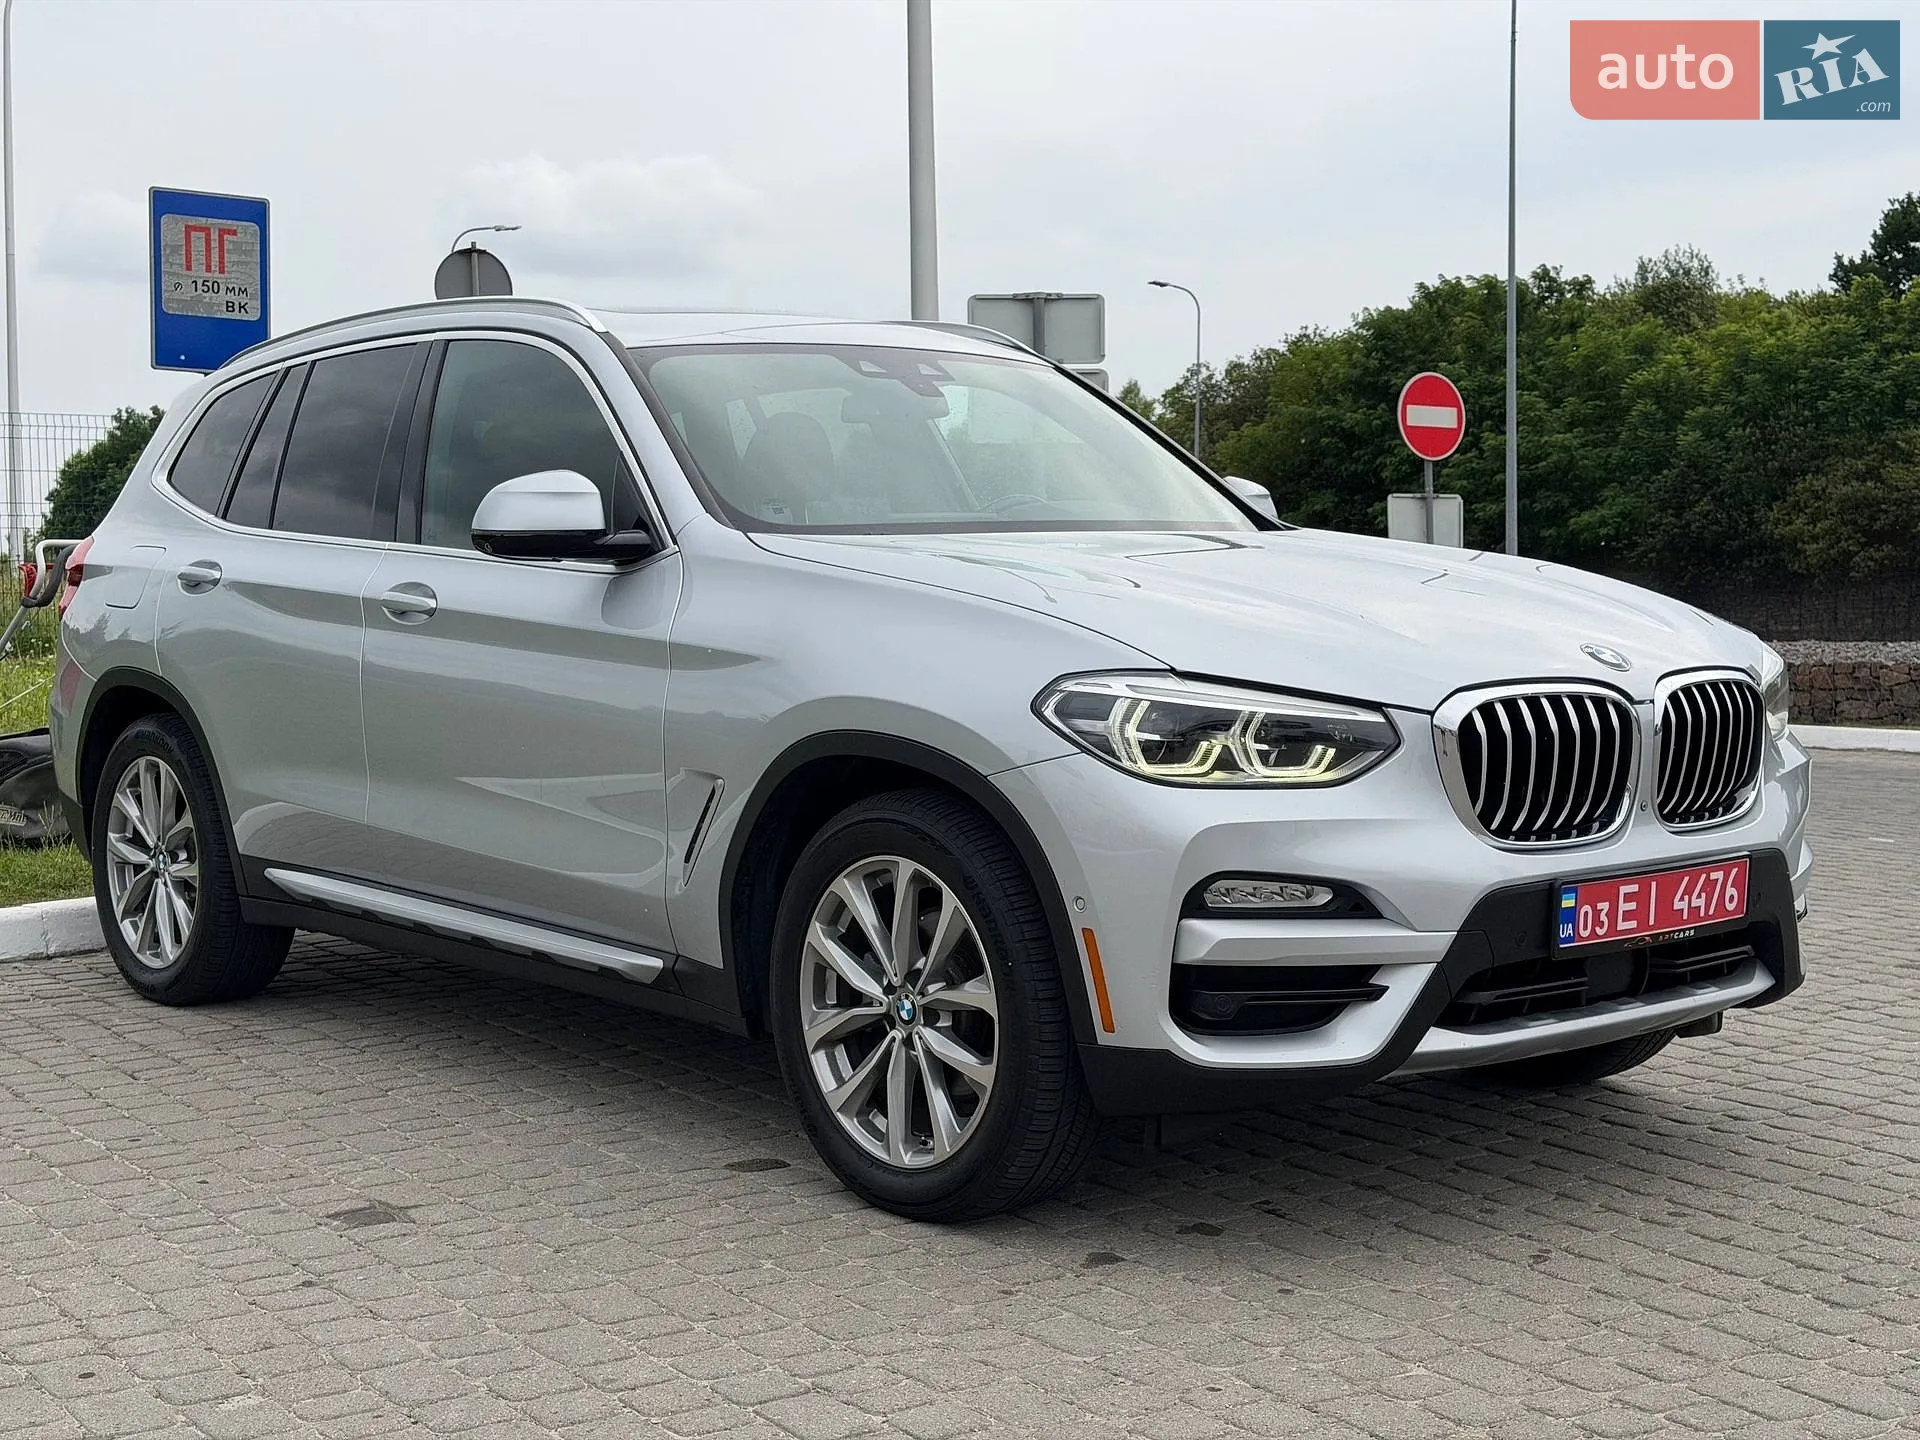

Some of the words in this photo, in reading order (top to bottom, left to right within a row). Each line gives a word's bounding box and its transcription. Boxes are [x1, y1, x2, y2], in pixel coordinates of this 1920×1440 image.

[184, 224, 238, 275] ПГ
[191, 279, 221, 295] 150
[1673, 867, 1739, 920] 4476
[1559, 923, 1574, 939] UA
